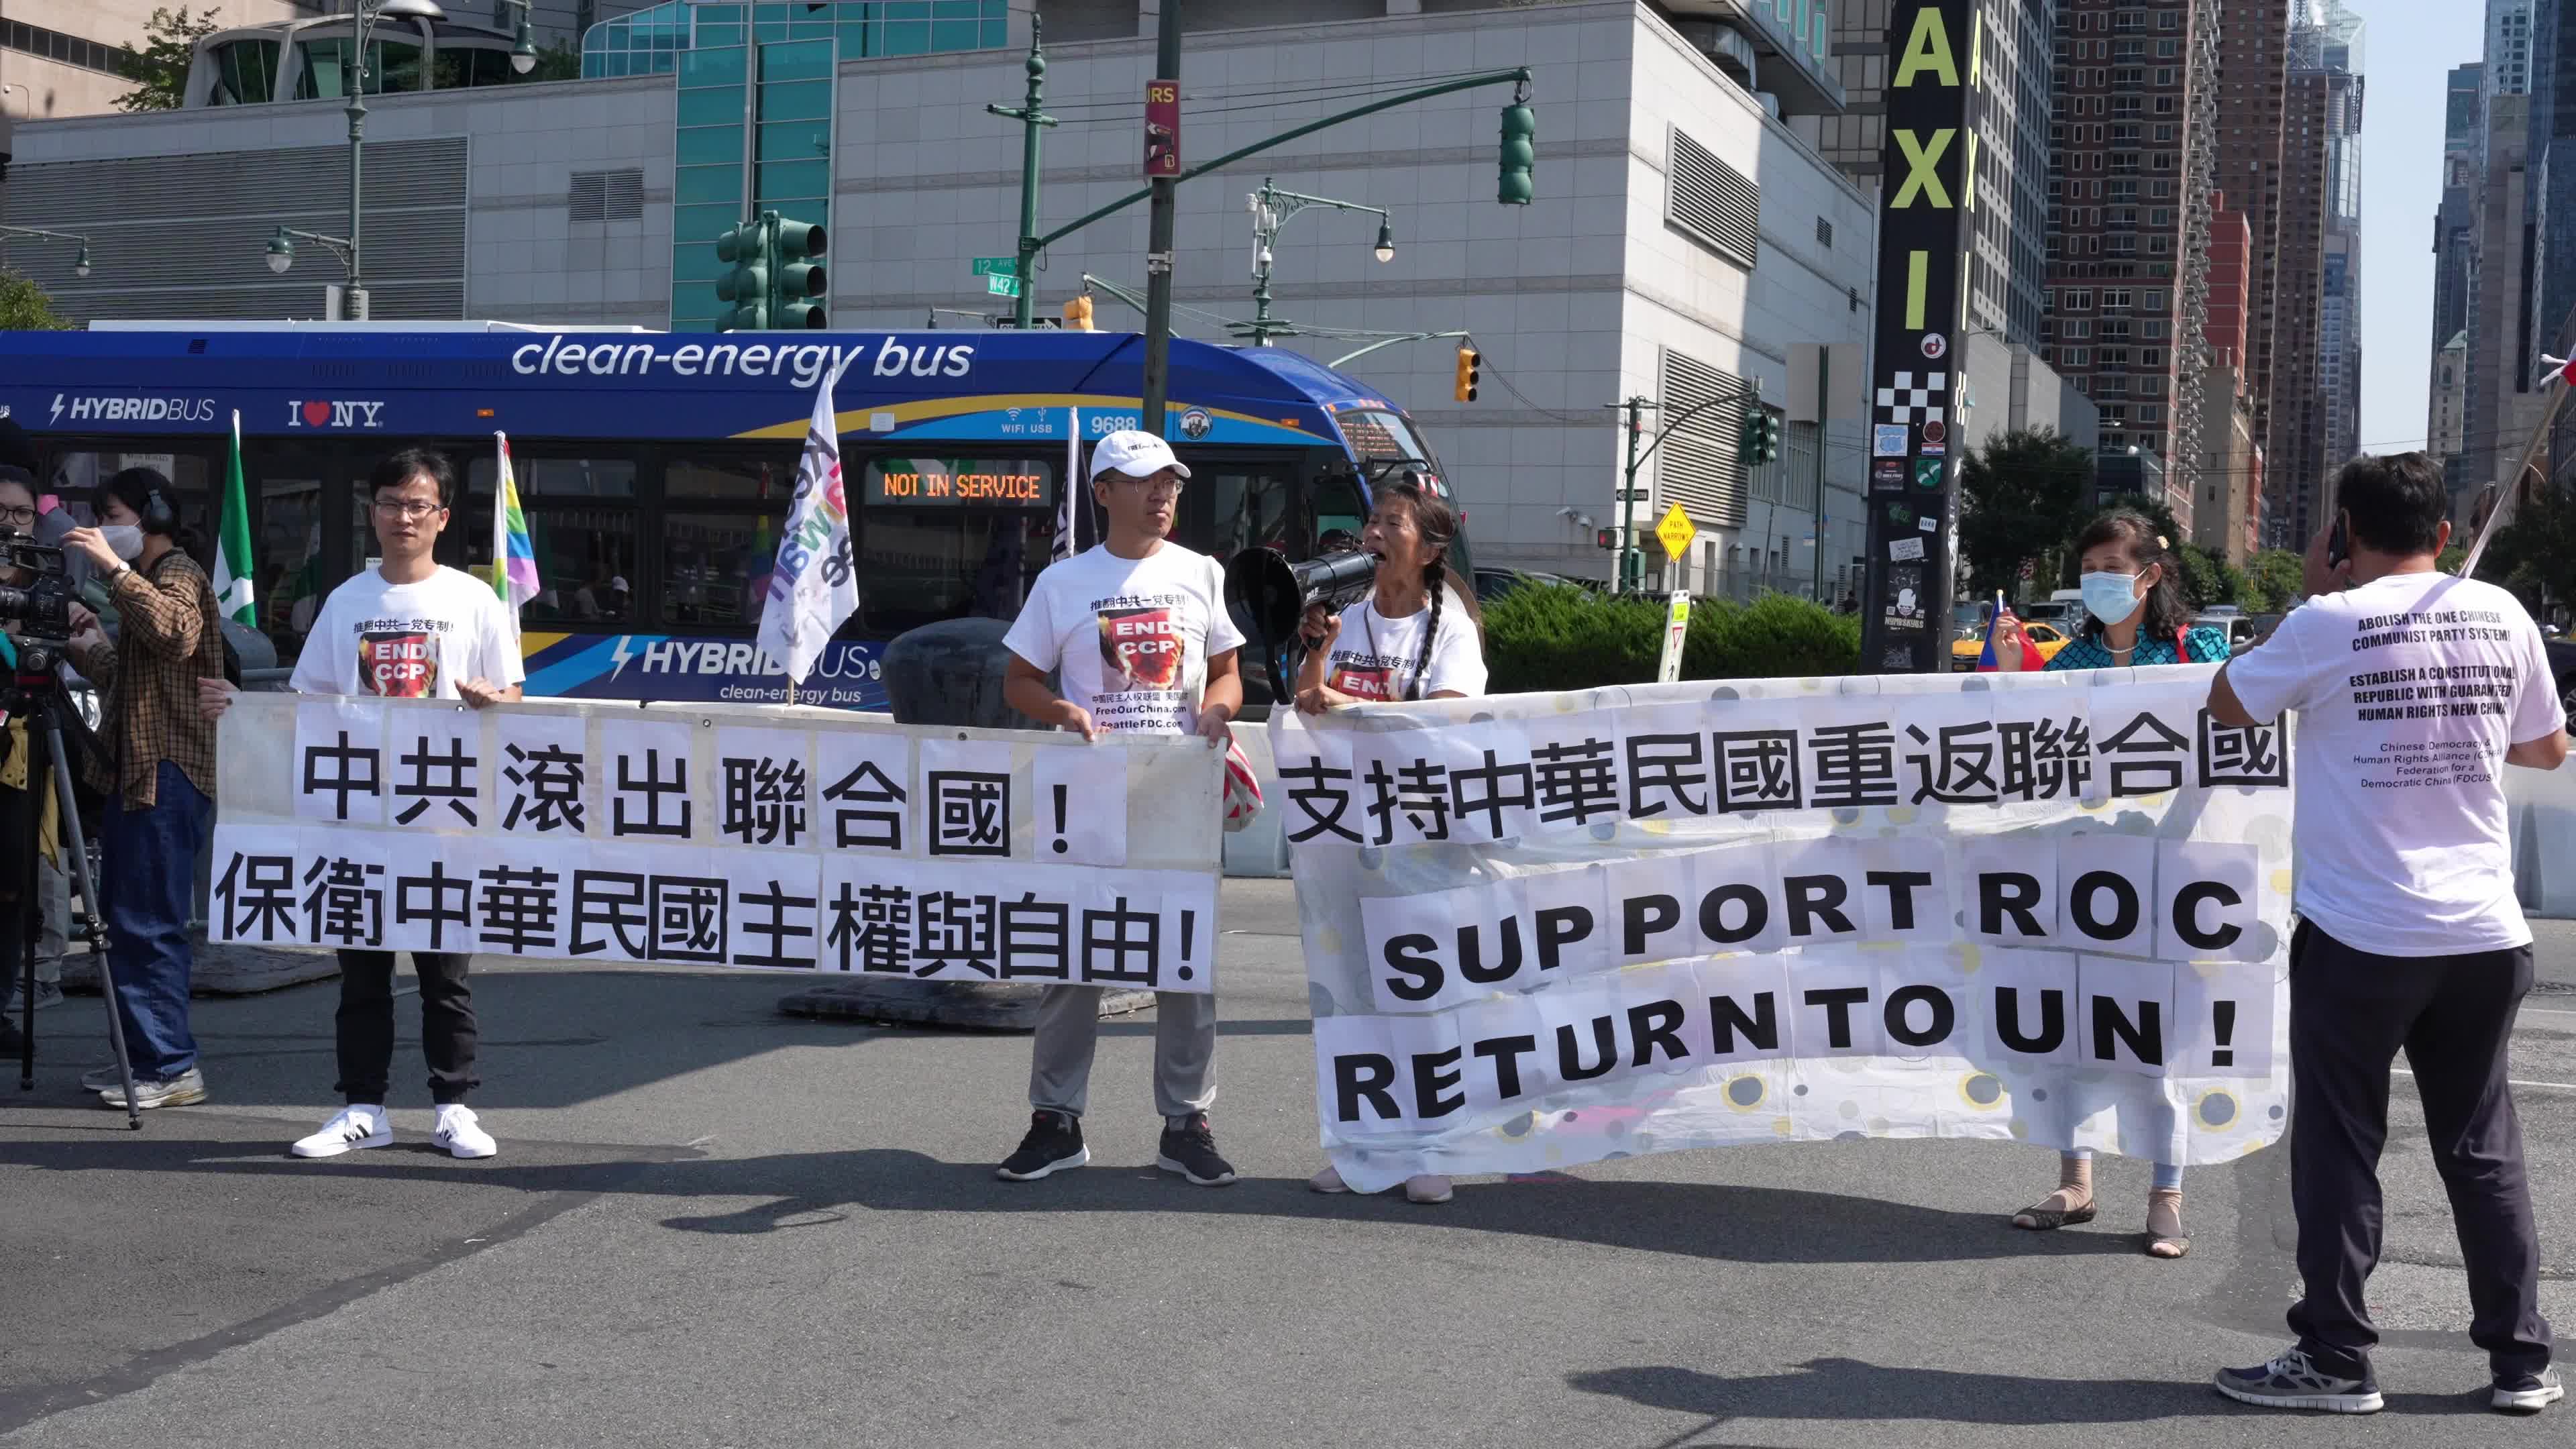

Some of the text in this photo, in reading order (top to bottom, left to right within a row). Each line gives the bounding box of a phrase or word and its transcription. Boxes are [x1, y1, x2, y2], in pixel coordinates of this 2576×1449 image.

[977, 260, 991, 274] 12
[512, 335, 975, 388] clean-energy bus
[288, 401, 384, 427] I NY
[1002, 423, 1052, 433] WIFI USB
[1091, 416, 1136, 433] 9688
[885, 474, 1040, 498] NOT IN SERVICE
[1670, 521, 1683, 529] PATH
[1663, 533, 1690, 541] NARROWS
[1116, 621, 1171, 635] END
[2358, 610, 2501, 631] ABOLISH THE ONE CHINESE
[1118, 640, 1175, 655] CCP
[2351, 627, 2511, 651] COMMUNIST PARTY SYSTEM!
[376, 643, 428, 660] END
[642, 642, 868, 679] HYBRIUS
[376, 663, 426, 680] CCP
[2349, 665, 2516, 687] ESTABLISH A CONSTITUTIONAL
[720, 684, 861, 704] clean-energy bus
[2353, 687, 2414, 704] REPUBLIC
[2417, 686, 2447, 699] WITH
[2358, 702, 2506, 721] HUMAN RIGHTS NEW CHINA
[1101, 720, 1183, 730] SeattleFDC.com
[2380, 743, 2425, 752] Chinese
[2428, 739, 2482, 750] Democracy
[2353, 755, 2390, 764] Human
[2394, 754, 2429, 765] Rights
[2432, 752, 2470, 762] Alliance
[1279, 707, 2289, 847] 支持中華民國重返聯合國
[2396, 765, 2449, 775] Federation
[2451, 763, 2466, 772] for
[2361, 777, 2421, 788] Democratic
[2424, 776, 2451, 787] China
[1383, 871, 2243, 1001] SUPPORT ROC
[1995, 987, 2163, 1067] UN
